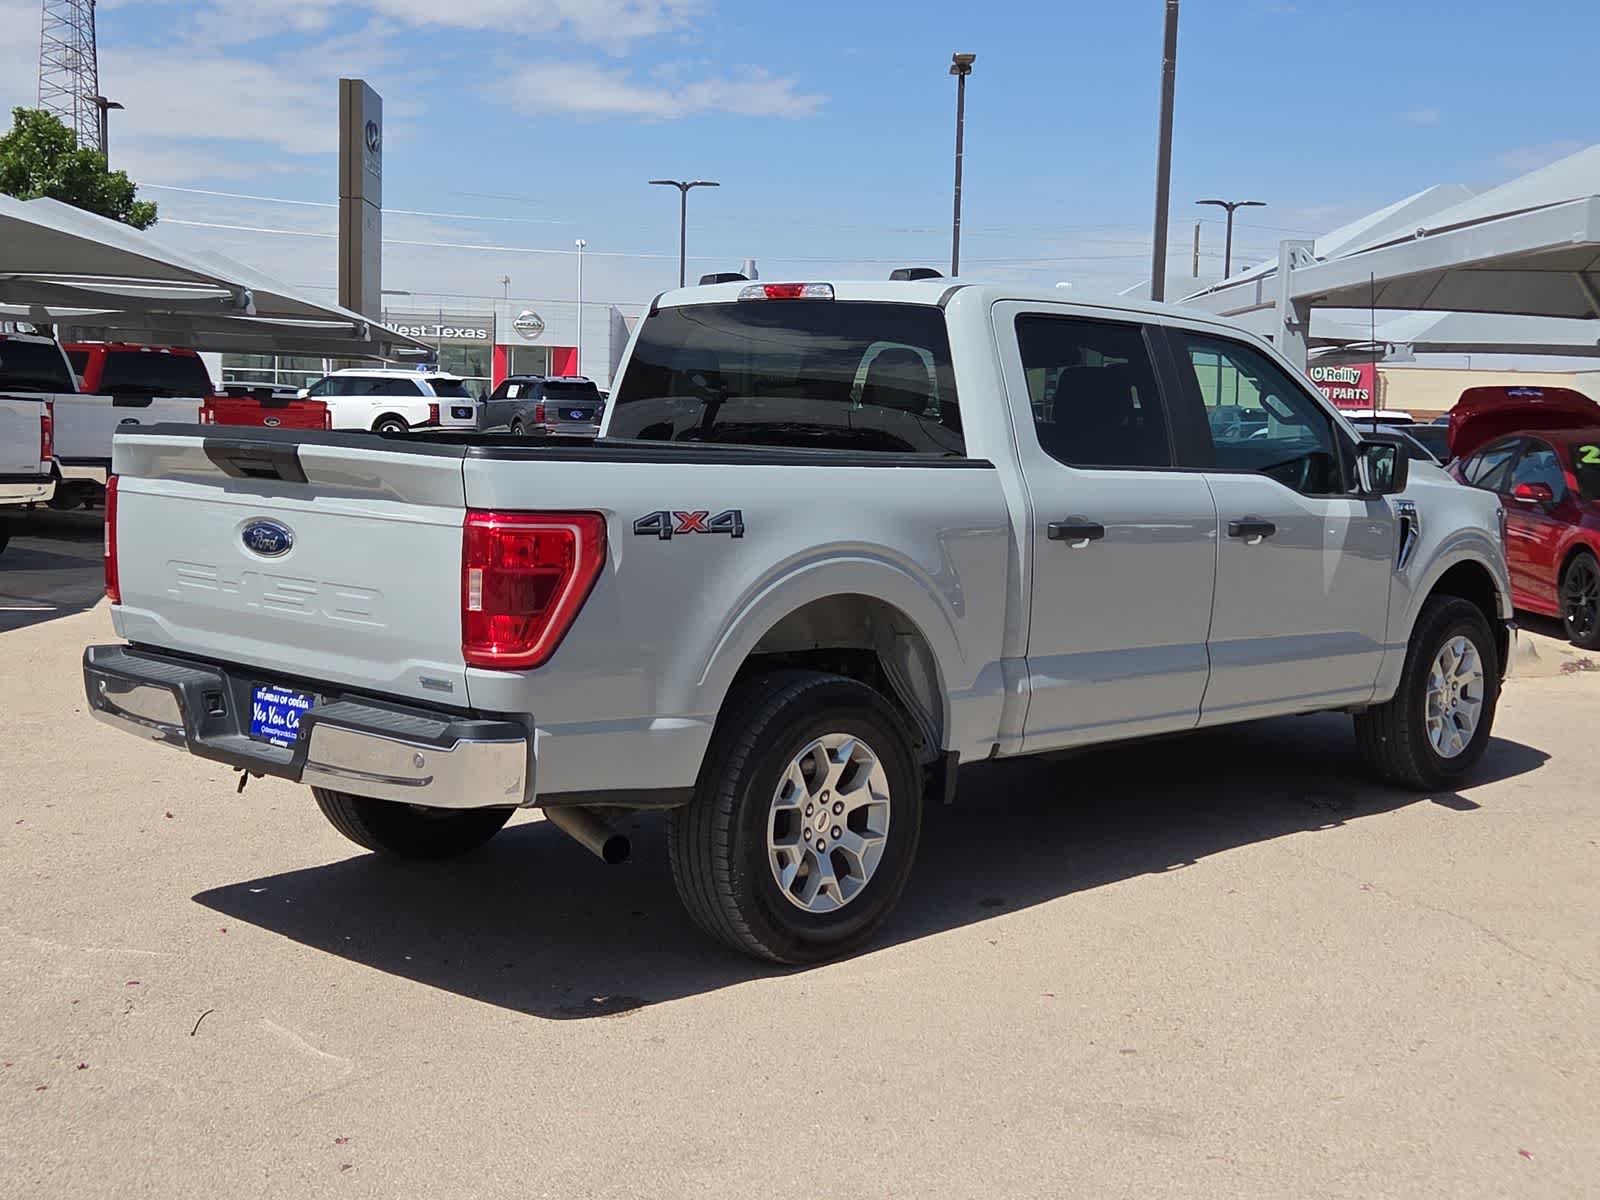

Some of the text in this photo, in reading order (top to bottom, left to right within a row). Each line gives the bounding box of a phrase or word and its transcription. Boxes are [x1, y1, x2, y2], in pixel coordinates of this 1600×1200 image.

[381, 323, 487, 339] West Texas
[1333, 387, 1369, 400] PARTS
[1579, 445, 1600, 464] 2
[250, 527, 279, 551] Ford
[252, 702, 267, 723] Yes
[268, 705, 286, 726] You
